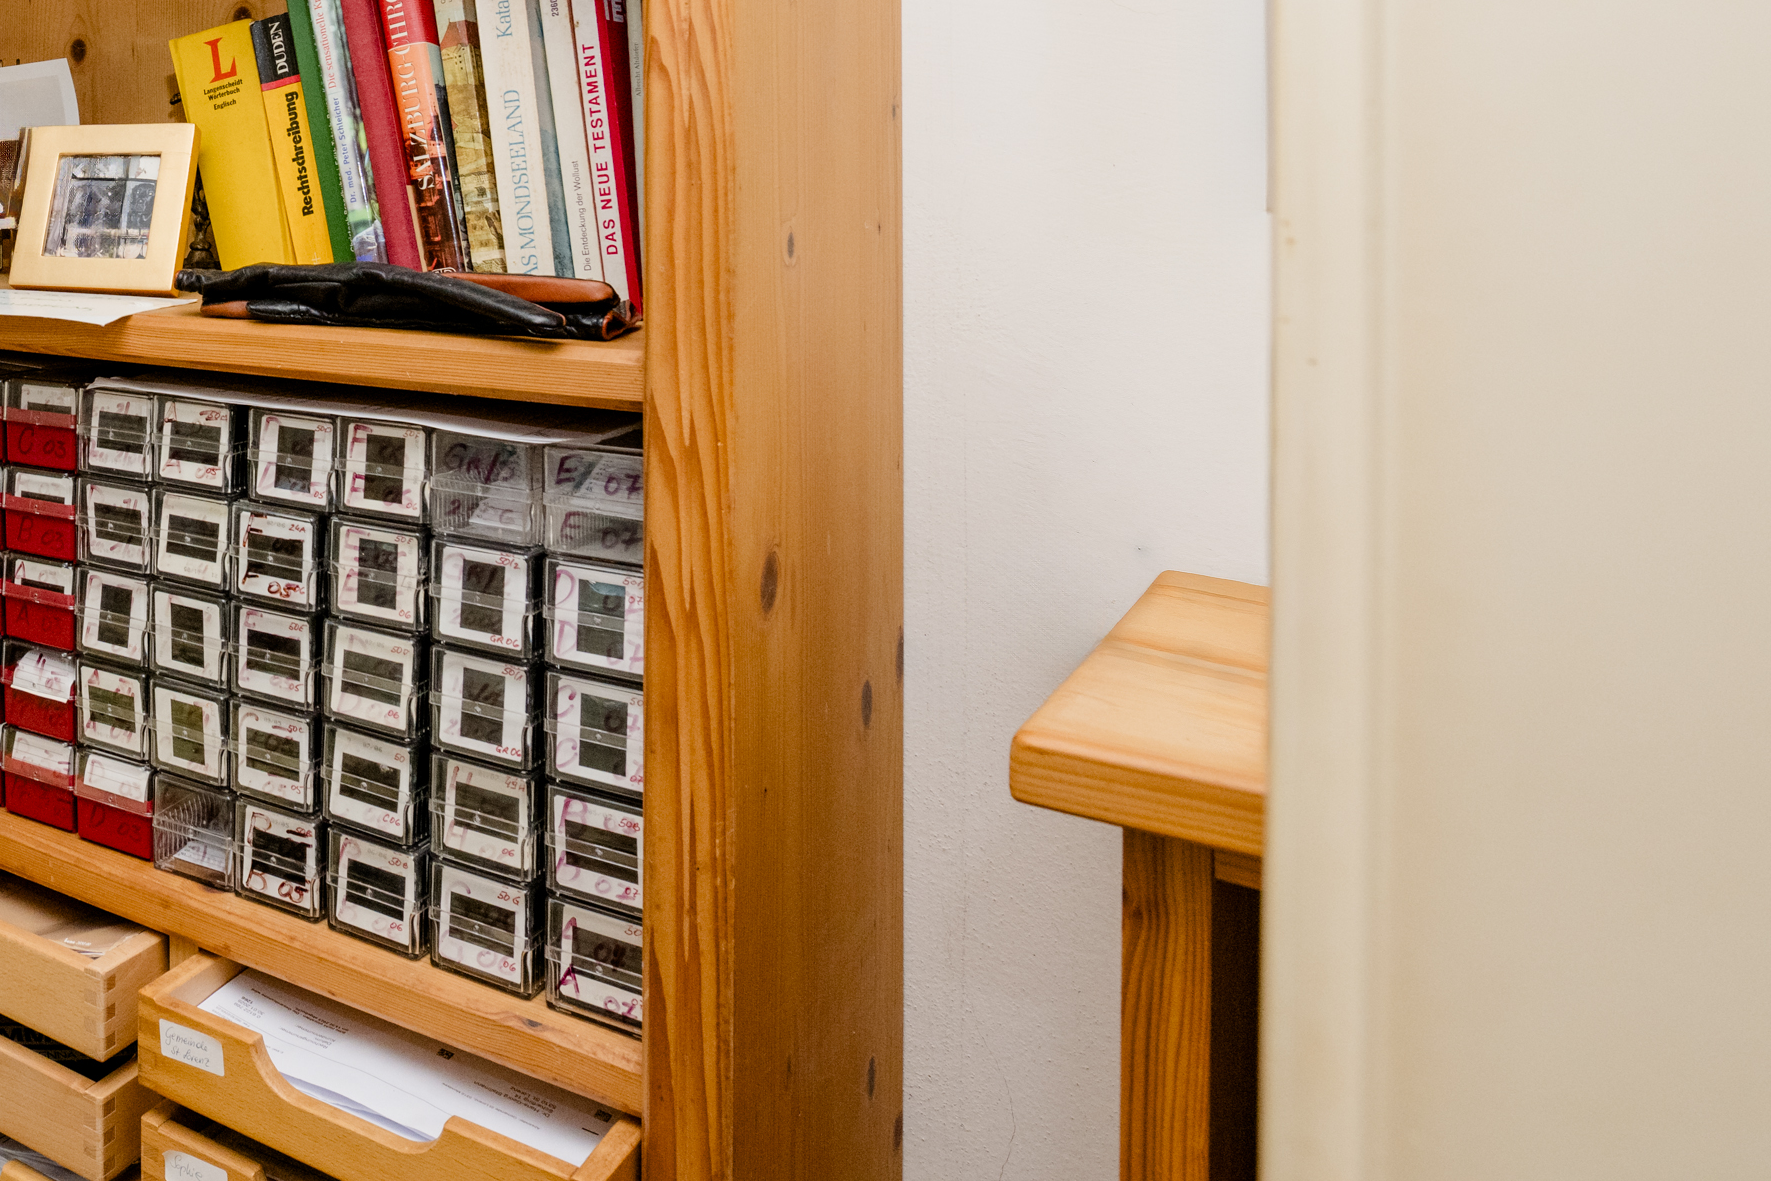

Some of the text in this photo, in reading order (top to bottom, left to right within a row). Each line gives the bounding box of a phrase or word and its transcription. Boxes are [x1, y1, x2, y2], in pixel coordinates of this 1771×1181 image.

[203, 37, 238, 84] L
[269, 21, 289, 75] DUDEN
[316, 13, 334, 68] sensationelle
[203, 79, 243, 95] Langenscheidt
[208, 87, 240, 101] Wörterbuch
[327, 70, 337, 90] Die
[214, 99, 237, 110] Englisch
[333, 96, 347, 139] Schleicher
[285, 91, 314, 217] Rechtschreibung
[343, 140, 352, 165] Peter
[504, 89, 536, 250] MONDSEELAND
[582, 43, 619, 256] DAS NEUE TESTAMENT
[346, 167, 355, 185] med.
[572, 161, 592, 272] Die Entdeckung der Wollust
[165, 1025, 208, 1053] Gemeinde
